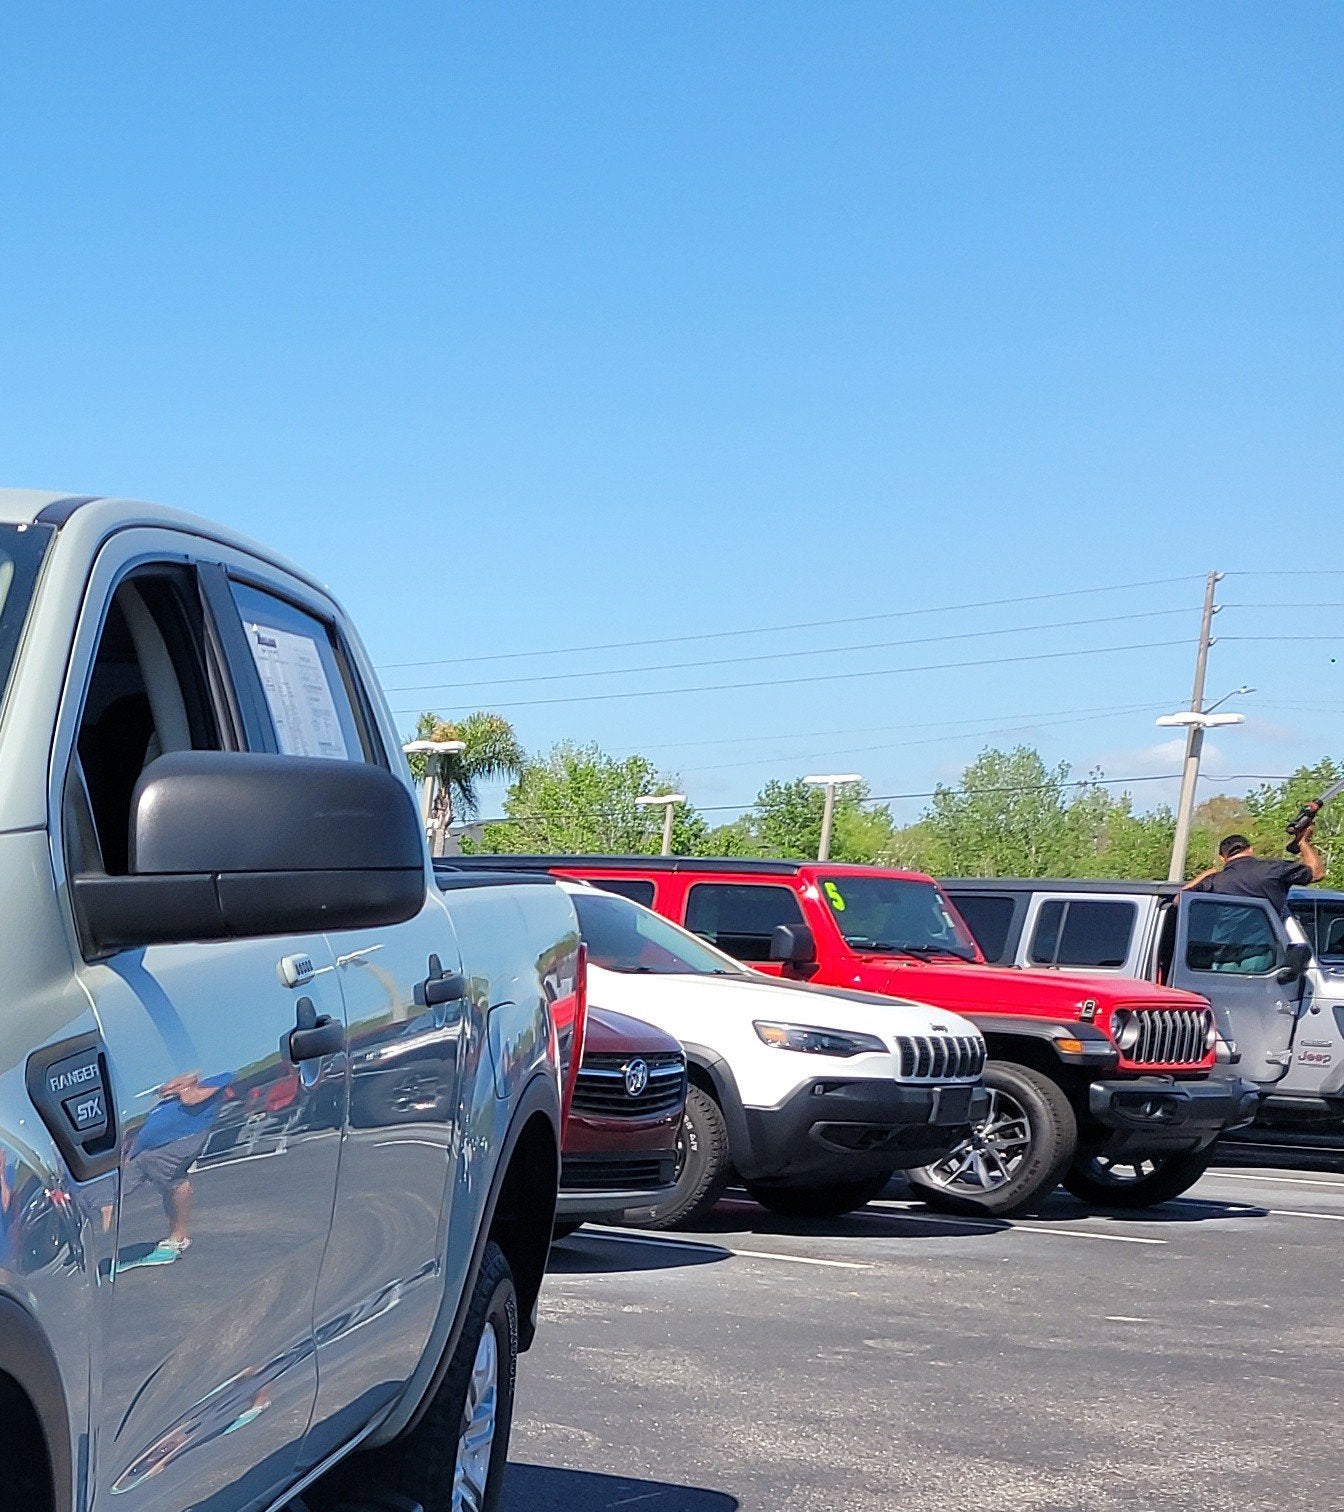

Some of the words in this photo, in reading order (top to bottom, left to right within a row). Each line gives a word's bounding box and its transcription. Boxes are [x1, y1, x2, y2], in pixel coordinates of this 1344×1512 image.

[824, 882, 846, 911] 5
[50, 1063, 100, 1092] RANGER
[77, 1097, 103, 1122] STX
